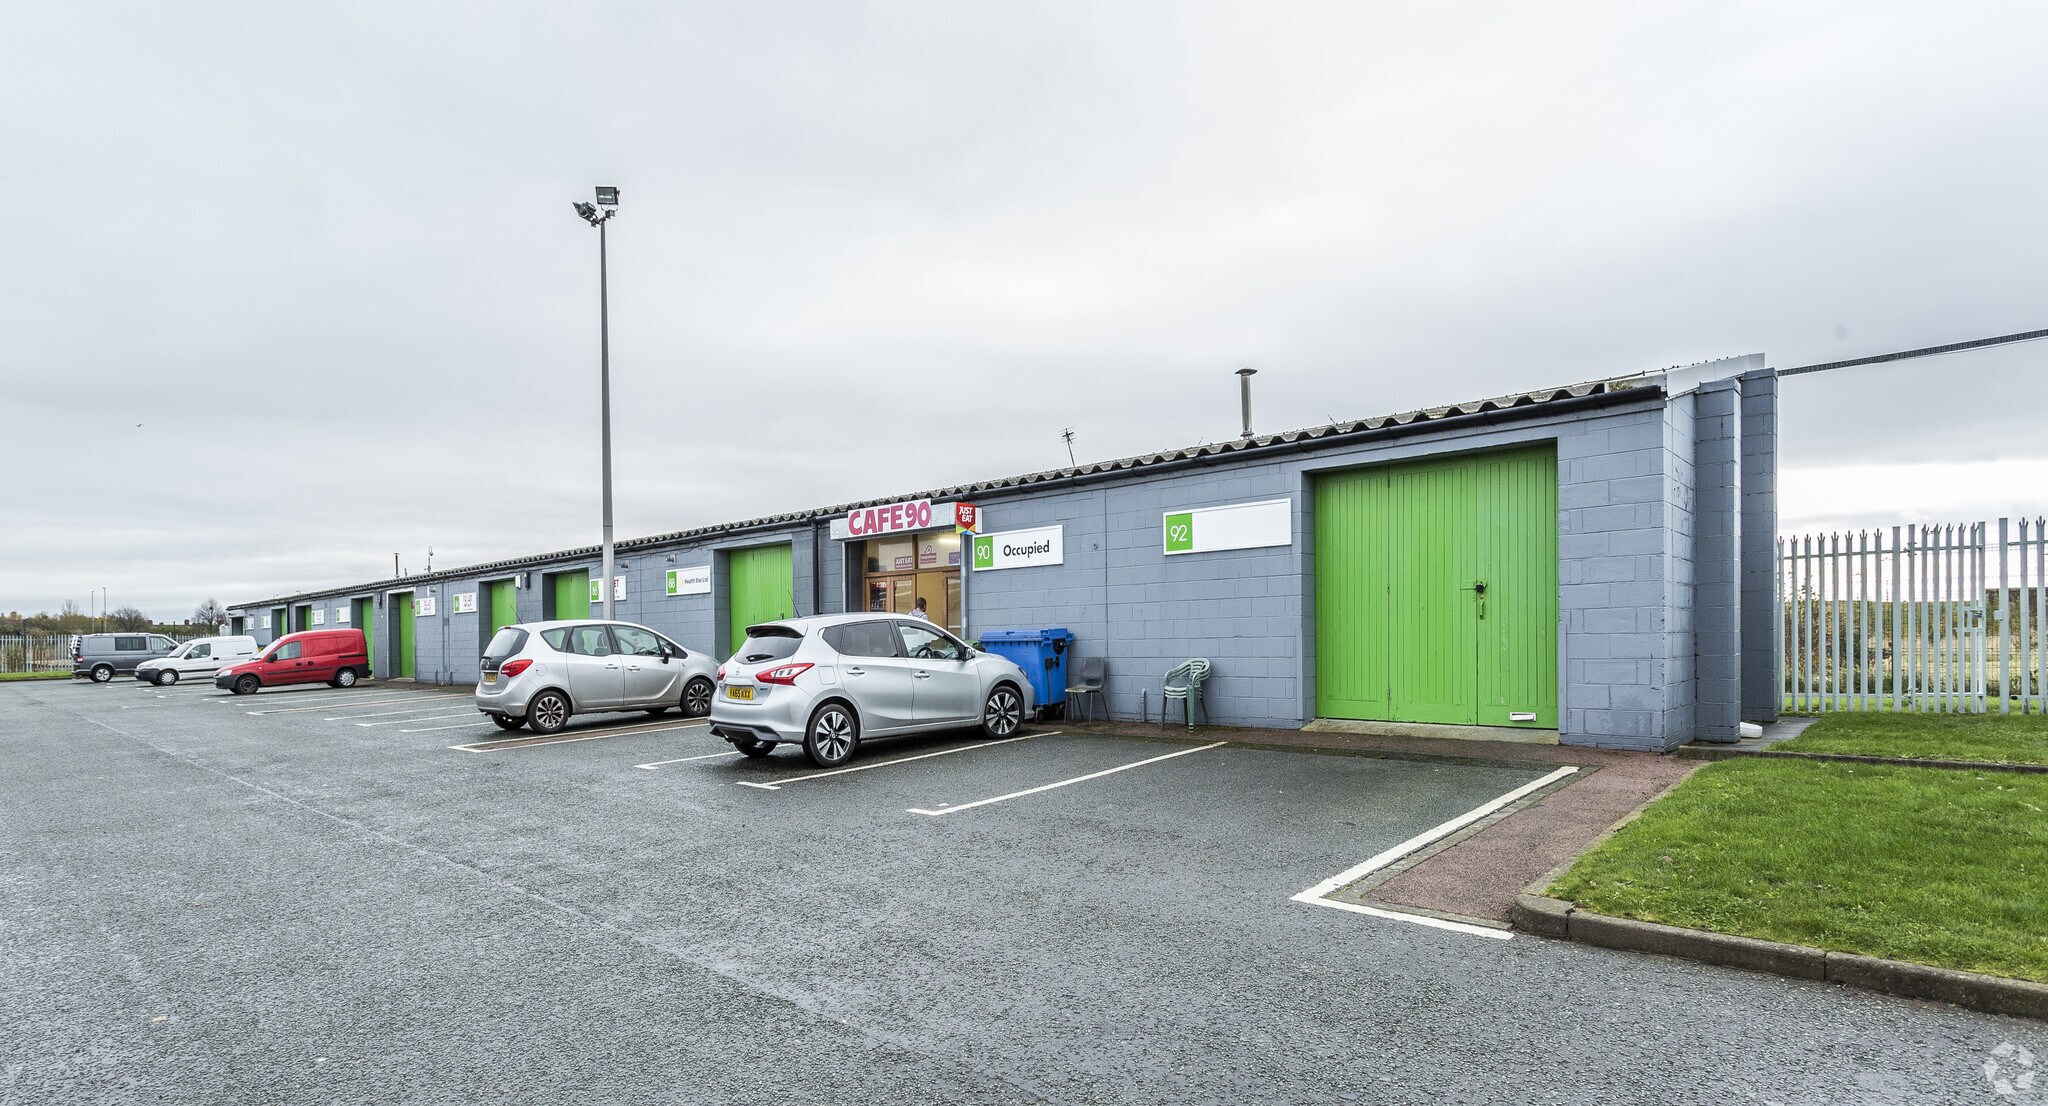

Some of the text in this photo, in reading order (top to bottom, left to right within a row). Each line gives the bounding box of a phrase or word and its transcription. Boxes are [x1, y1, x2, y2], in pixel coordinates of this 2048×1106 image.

[959, 506, 973, 515] JUST
[961, 514, 973, 522] EAT
[1170, 524, 1188, 542] 92
[977, 545, 990, 560] 90
[1003, 539, 1050, 558] Occupied
[668, 577, 676, 588] 88
[592, 586, 598, 596] 86
